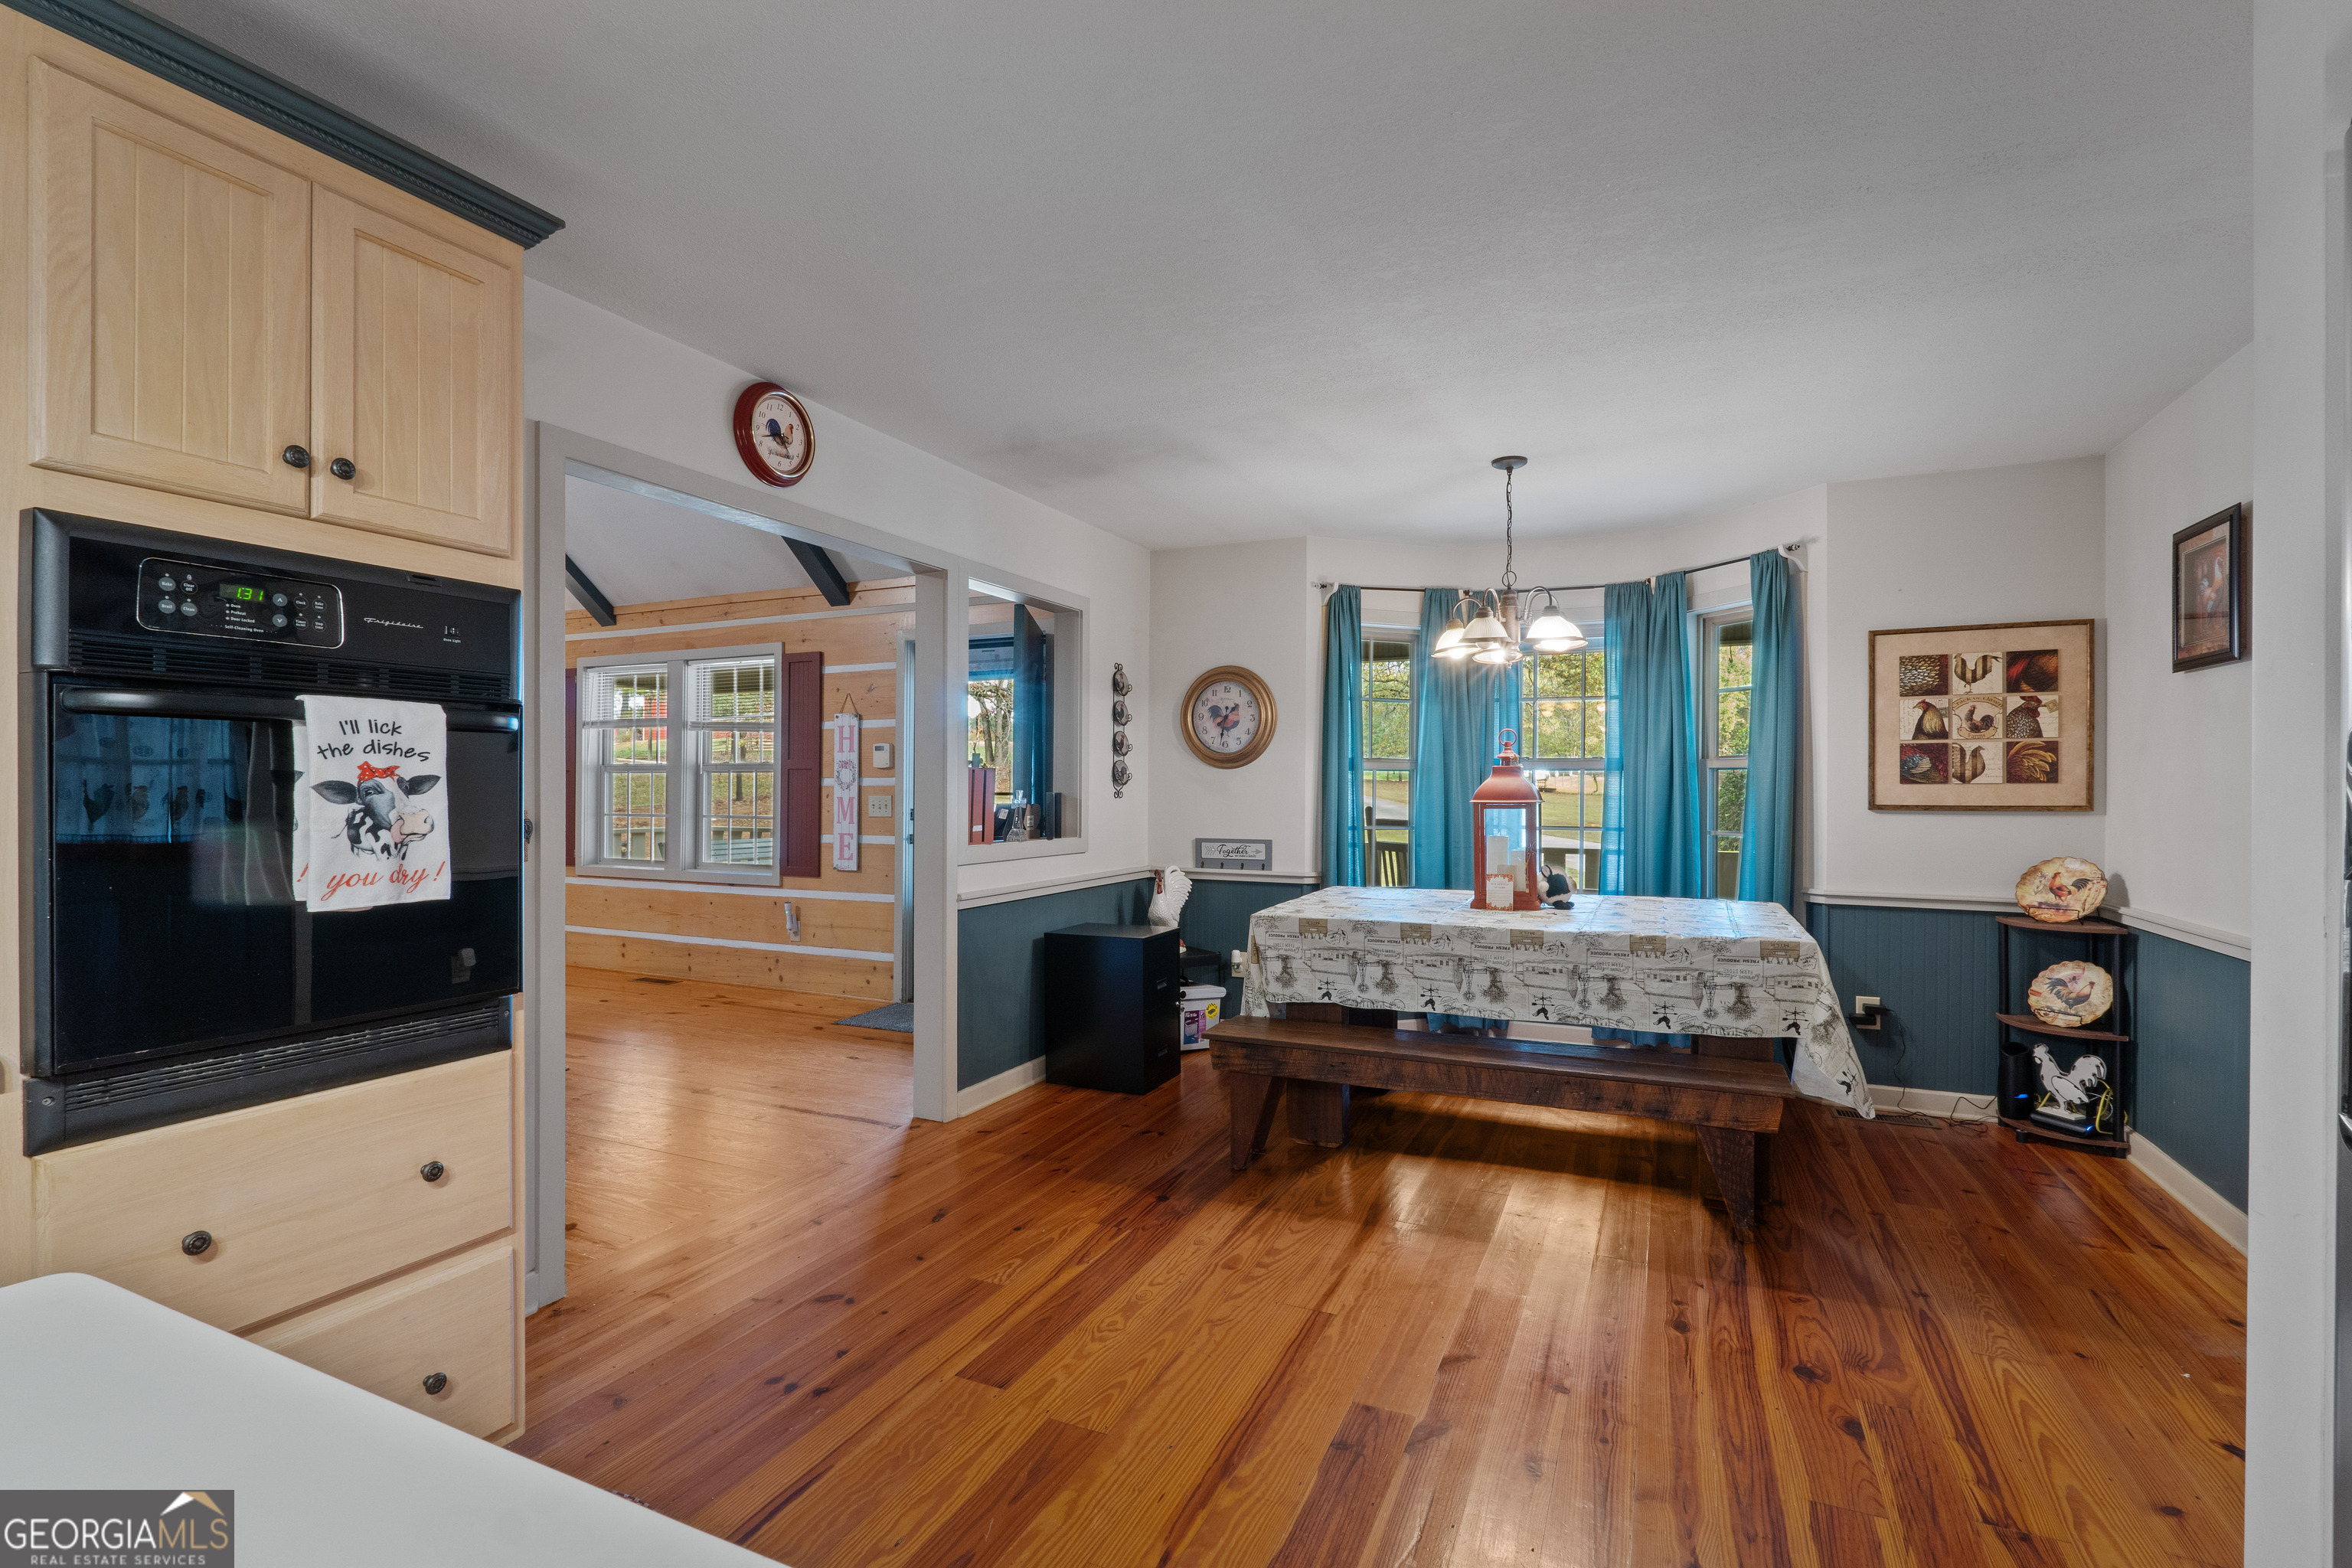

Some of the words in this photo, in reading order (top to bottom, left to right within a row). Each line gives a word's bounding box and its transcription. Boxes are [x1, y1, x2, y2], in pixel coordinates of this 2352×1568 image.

[766, 403, 773, 411] 11
[777, 403, 784, 411] 12
[758, 410, 766, 419] 10
[237, 587, 263, 601] 1:31
[364, 617, 423, 629] Frigidaire
[1246, 700, 1253, 708] 2
[1955, 697, 1971, 706] rack
[1198, 713, 1204, 721] 9
[338, 719, 361, 736] I'll
[368, 719, 403, 736] lick
[1211, 737, 1216, 745] 7
[1236, 737, 1242, 745] 5
[316, 743, 354, 760] the
[363, 739, 431, 762] dishes
[1217, 844, 1251, 858] Together
[320, 871, 384, 902] you
[389, 863, 430, 894] dry
